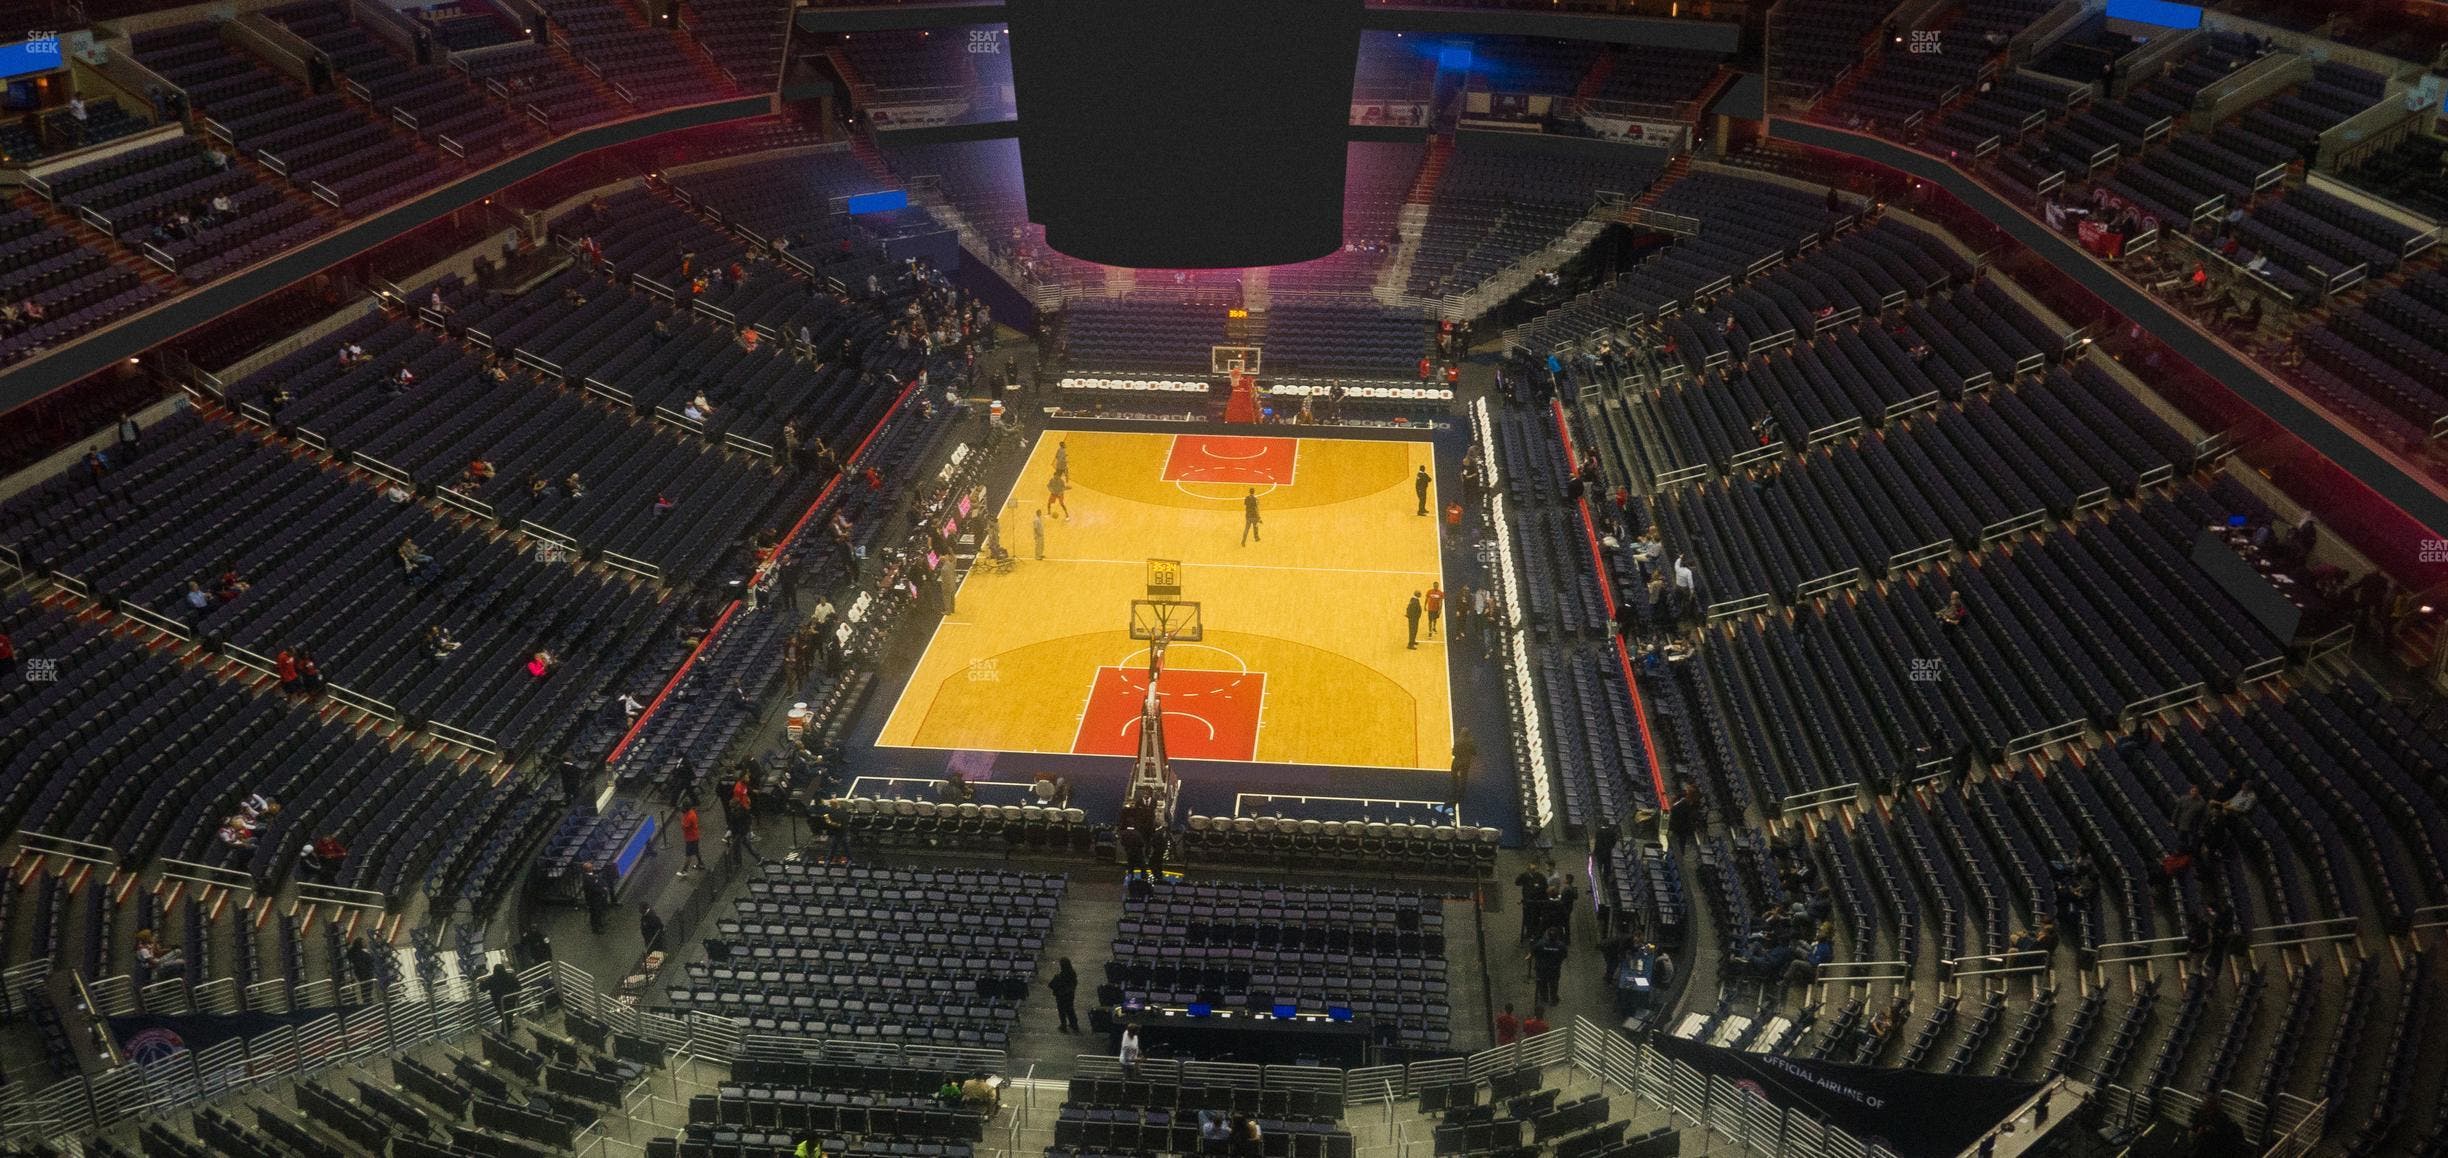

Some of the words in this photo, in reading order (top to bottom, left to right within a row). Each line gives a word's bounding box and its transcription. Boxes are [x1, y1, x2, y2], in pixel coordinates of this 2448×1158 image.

[1763, 1056, 1814, 1083] OFFICIAL
[1817, 1077, 1864, 1103] AIRLINE
[1866, 1096, 1885, 1109] OF
